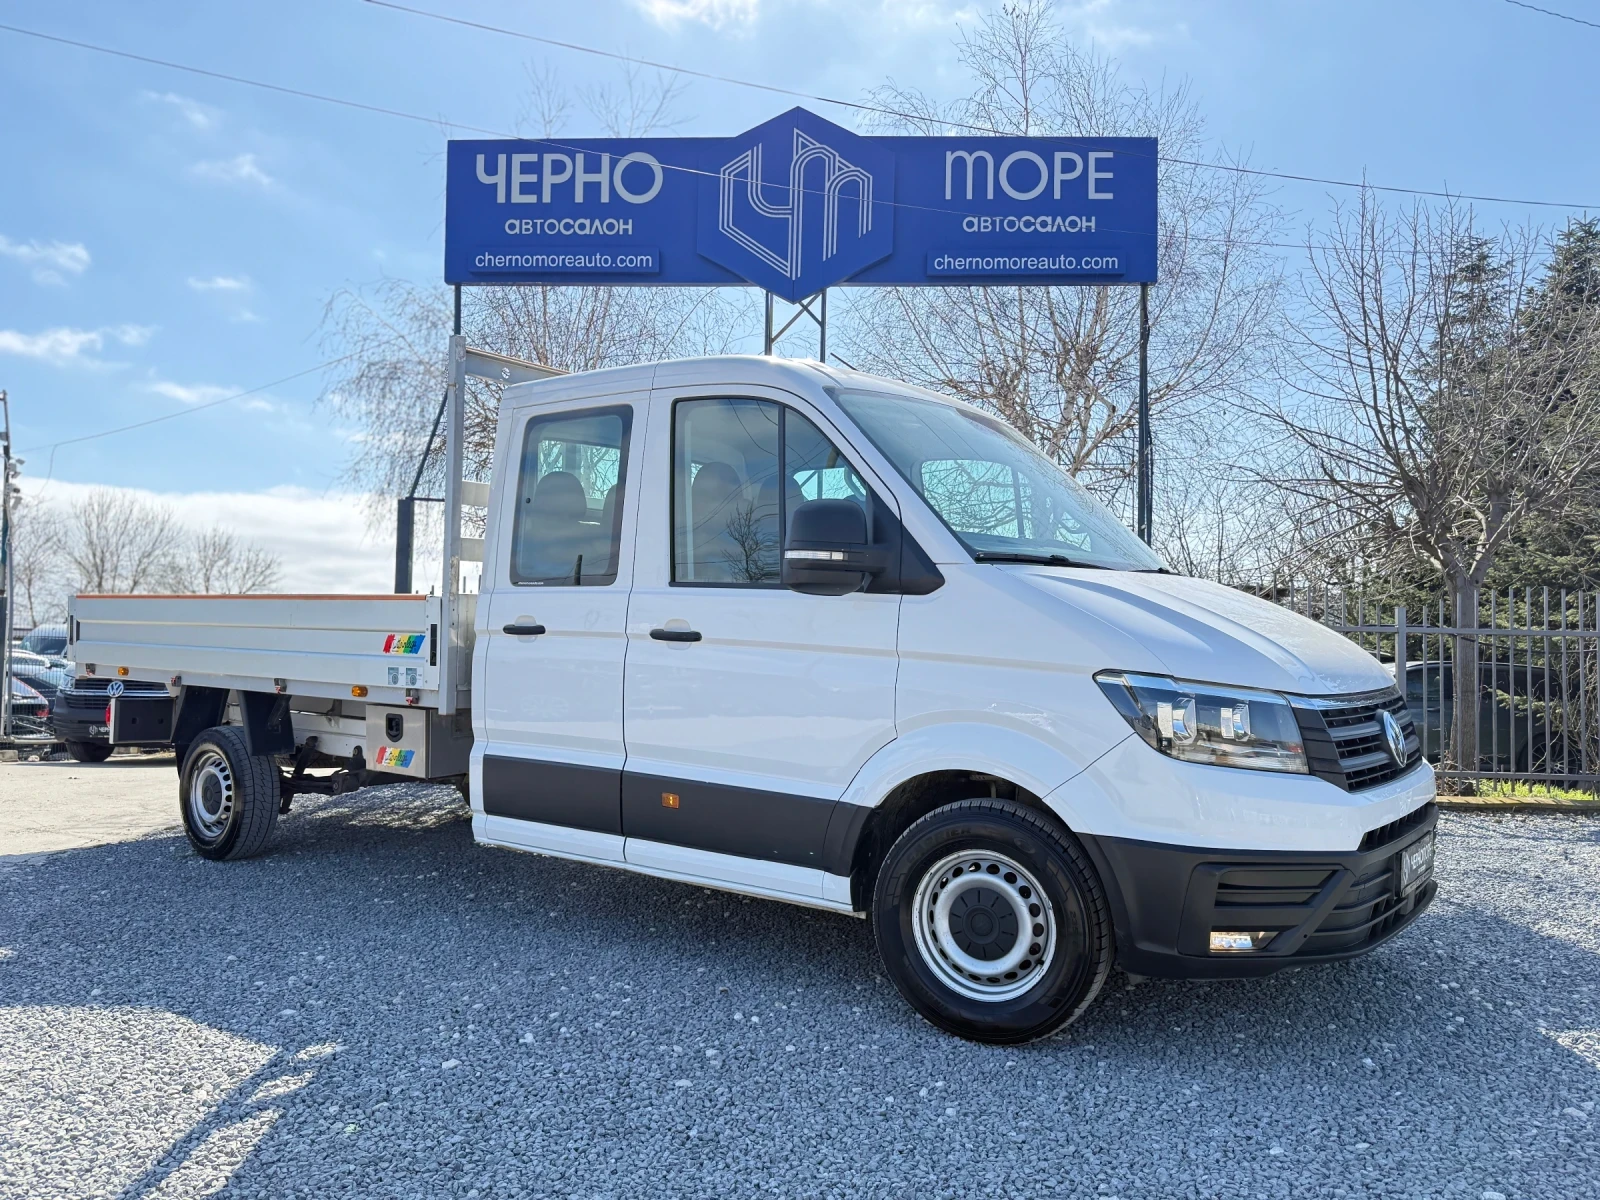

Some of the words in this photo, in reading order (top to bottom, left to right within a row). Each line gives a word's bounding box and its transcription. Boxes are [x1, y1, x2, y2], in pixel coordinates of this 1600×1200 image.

[476, 151, 664, 204] ЧЕРНО
[945, 150, 1114, 200] МОРЕ
[475, 252, 652, 268] chernomoreauto.com
[934, 254, 1119, 270] chernomoreauto.com
